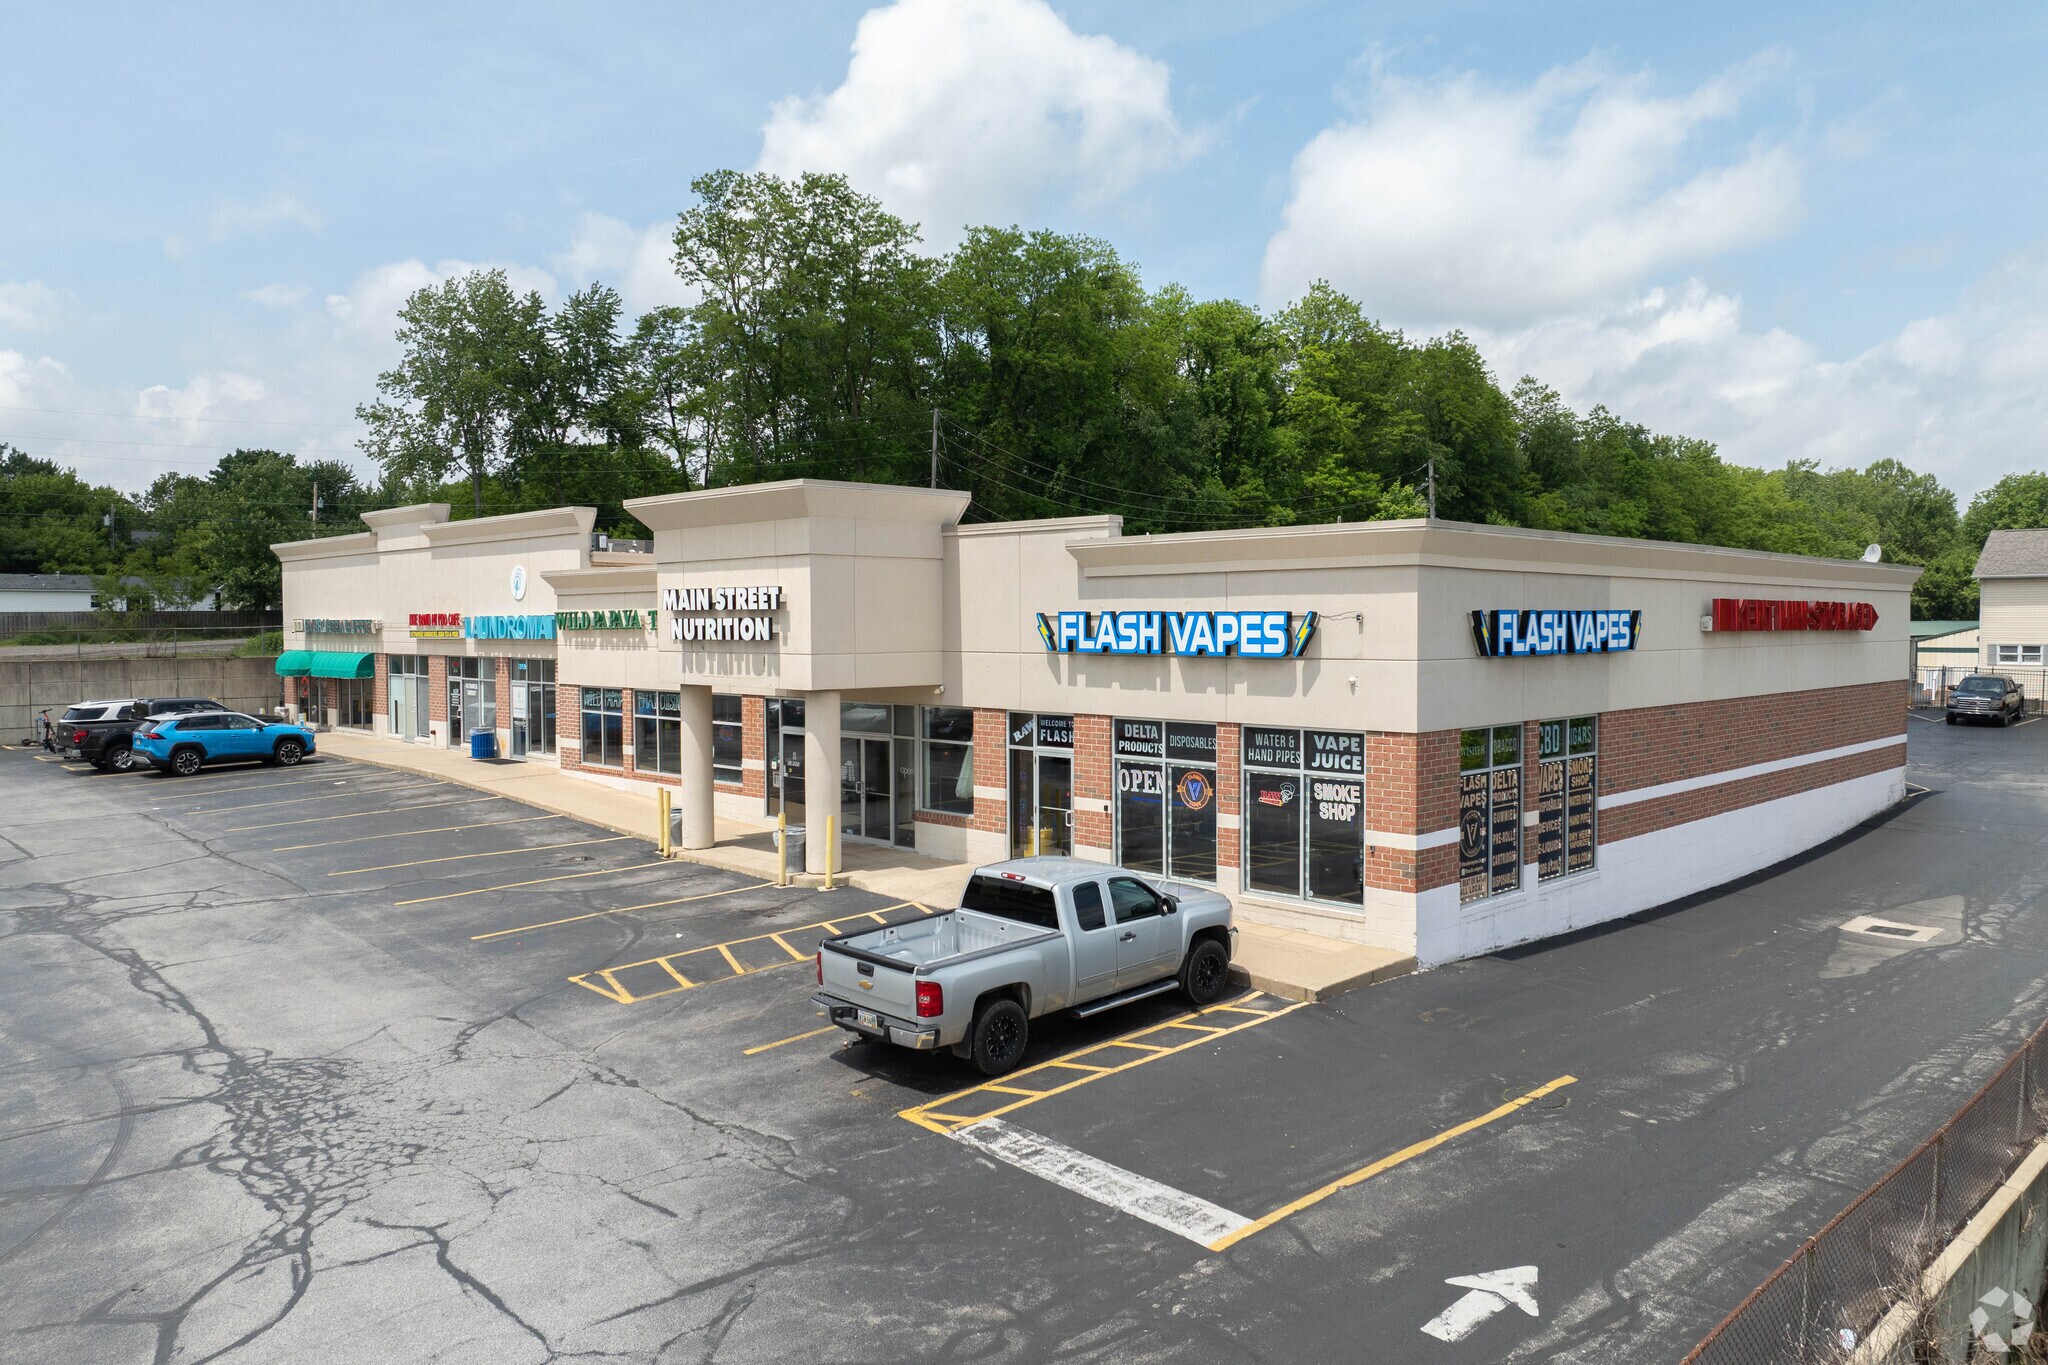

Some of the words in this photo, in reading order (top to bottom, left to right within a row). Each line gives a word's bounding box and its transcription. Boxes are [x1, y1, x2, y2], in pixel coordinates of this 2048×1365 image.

[662, 588, 710, 610] MAIN
[715, 586, 779, 610] STREET
[464, 615, 556, 640] LAUNDROMAT
[555, 611, 591, 631] WILD
[592, 609, 642, 630] PAPAYA
[671, 617, 770, 641] NUTRITION
[1058, 612, 1162, 654] FLASH
[1167, 612, 1288, 657] VAPES
[1498, 610, 1567, 656] FLASH
[1570, 610, 1631, 653] VAPES
[1013, 719, 1034, 742] RAW
[1040, 719, 1067, 728] WELCOME
[1124, 723, 1158, 739] DELTA
[1040, 729, 1074, 743] FLASH
[1169, 735, 1217, 750] DISPOSABLES
[1255, 733, 1286, 747] WATER
[1289, 735, 1294, 748] &
[1313, 734, 1360, 752] VAPE
[1539, 724, 1560, 755] CBD
[1118, 740, 1163, 754] PRODUCTS
[1493, 737, 1517, 754] OBACCO
[1248, 748, 1273, 762] HAND
[1275, 749, 1300, 764] PIPES
[1311, 752, 1362, 771] JUICE
[1569, 758, 1593, 776] SMOKE
[1119, 768, 1163, 794] OPEN
[1493, 769, 1518, 790] DELTA
[1571, 774, 1590, 788] SHOP
[1260, 790, 1281, 801] RAW
[1313, 783, 1361, 804] SMOKE
[1319, 802, 1356, 821] SHOP
[1539, 820, 1561, 833] DEVICES
